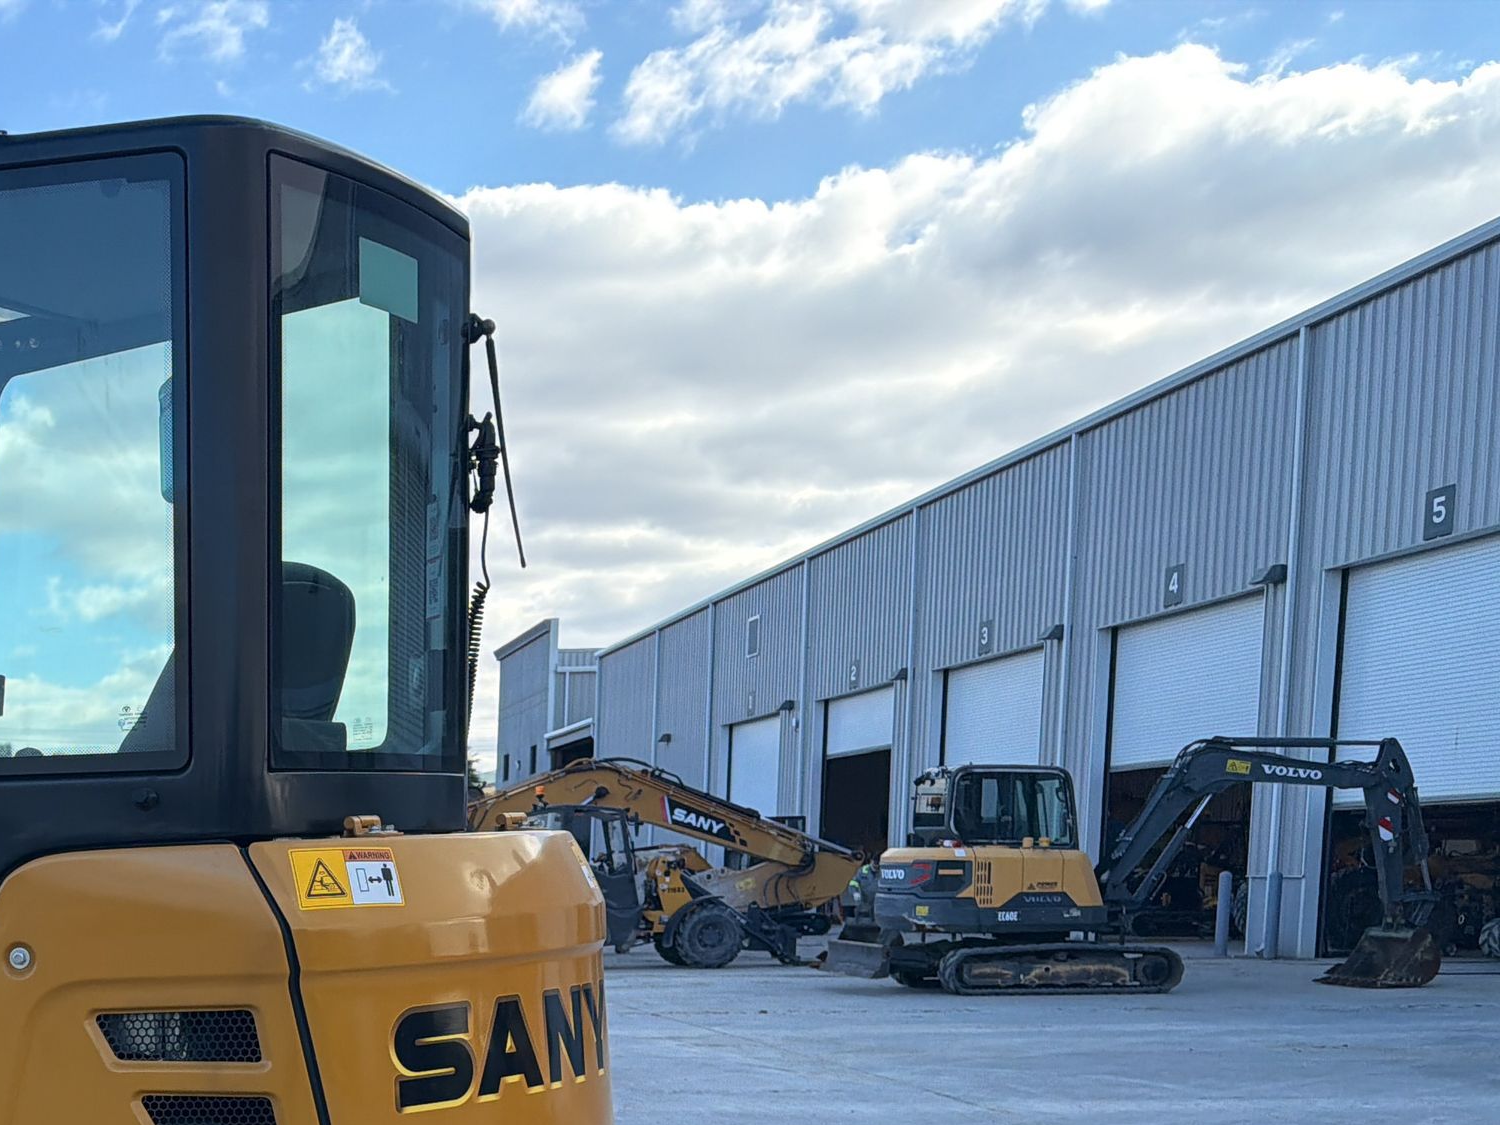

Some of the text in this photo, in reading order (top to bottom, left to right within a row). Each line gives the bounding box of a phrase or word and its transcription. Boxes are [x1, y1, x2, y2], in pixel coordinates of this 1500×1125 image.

[1432, 495, 1446, 524] 5
[1168, 571, 1178, 594] 4
[981, 626, 988, 645] 3
[850, 665, 857, 681] 2
[1261, 763, 1323, 780] VOLVO
[672, 807, 725, 834] SANY
[355, 850, 390, 860] WARNING
[881, 868, 905, 880] VOLVO
[997, 911, 1019, 922] EC60E
[392, 978, 605, 1110] SANY
